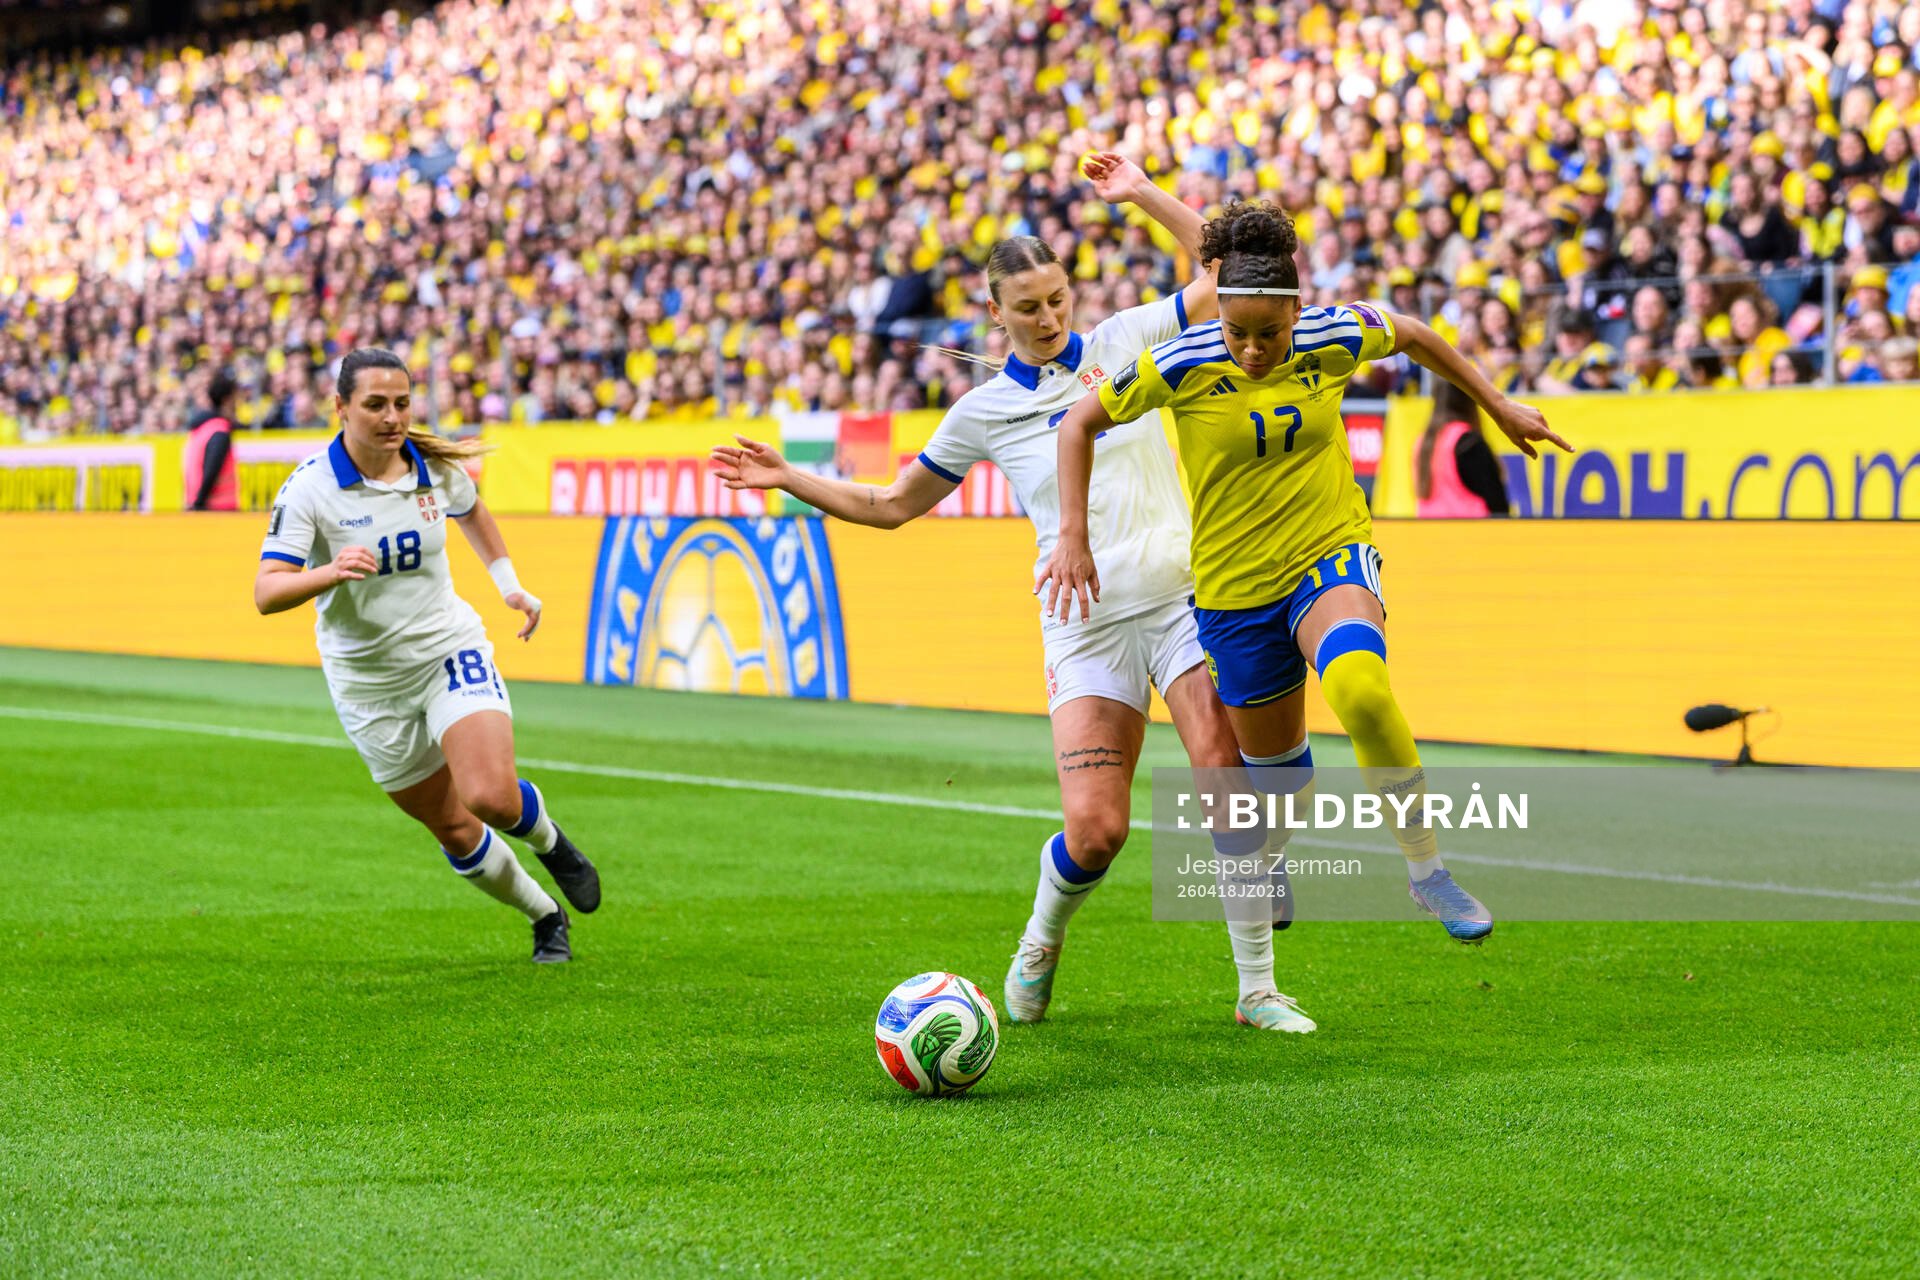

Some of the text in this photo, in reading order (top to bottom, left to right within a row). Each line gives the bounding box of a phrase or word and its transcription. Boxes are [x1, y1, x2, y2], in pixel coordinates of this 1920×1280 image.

[1250, 405, 1302, 458] 17
[377, 529, 422, 577] 18
[1306, 546, 1352, 589] 17
[443, 649, 489, 693] 18
